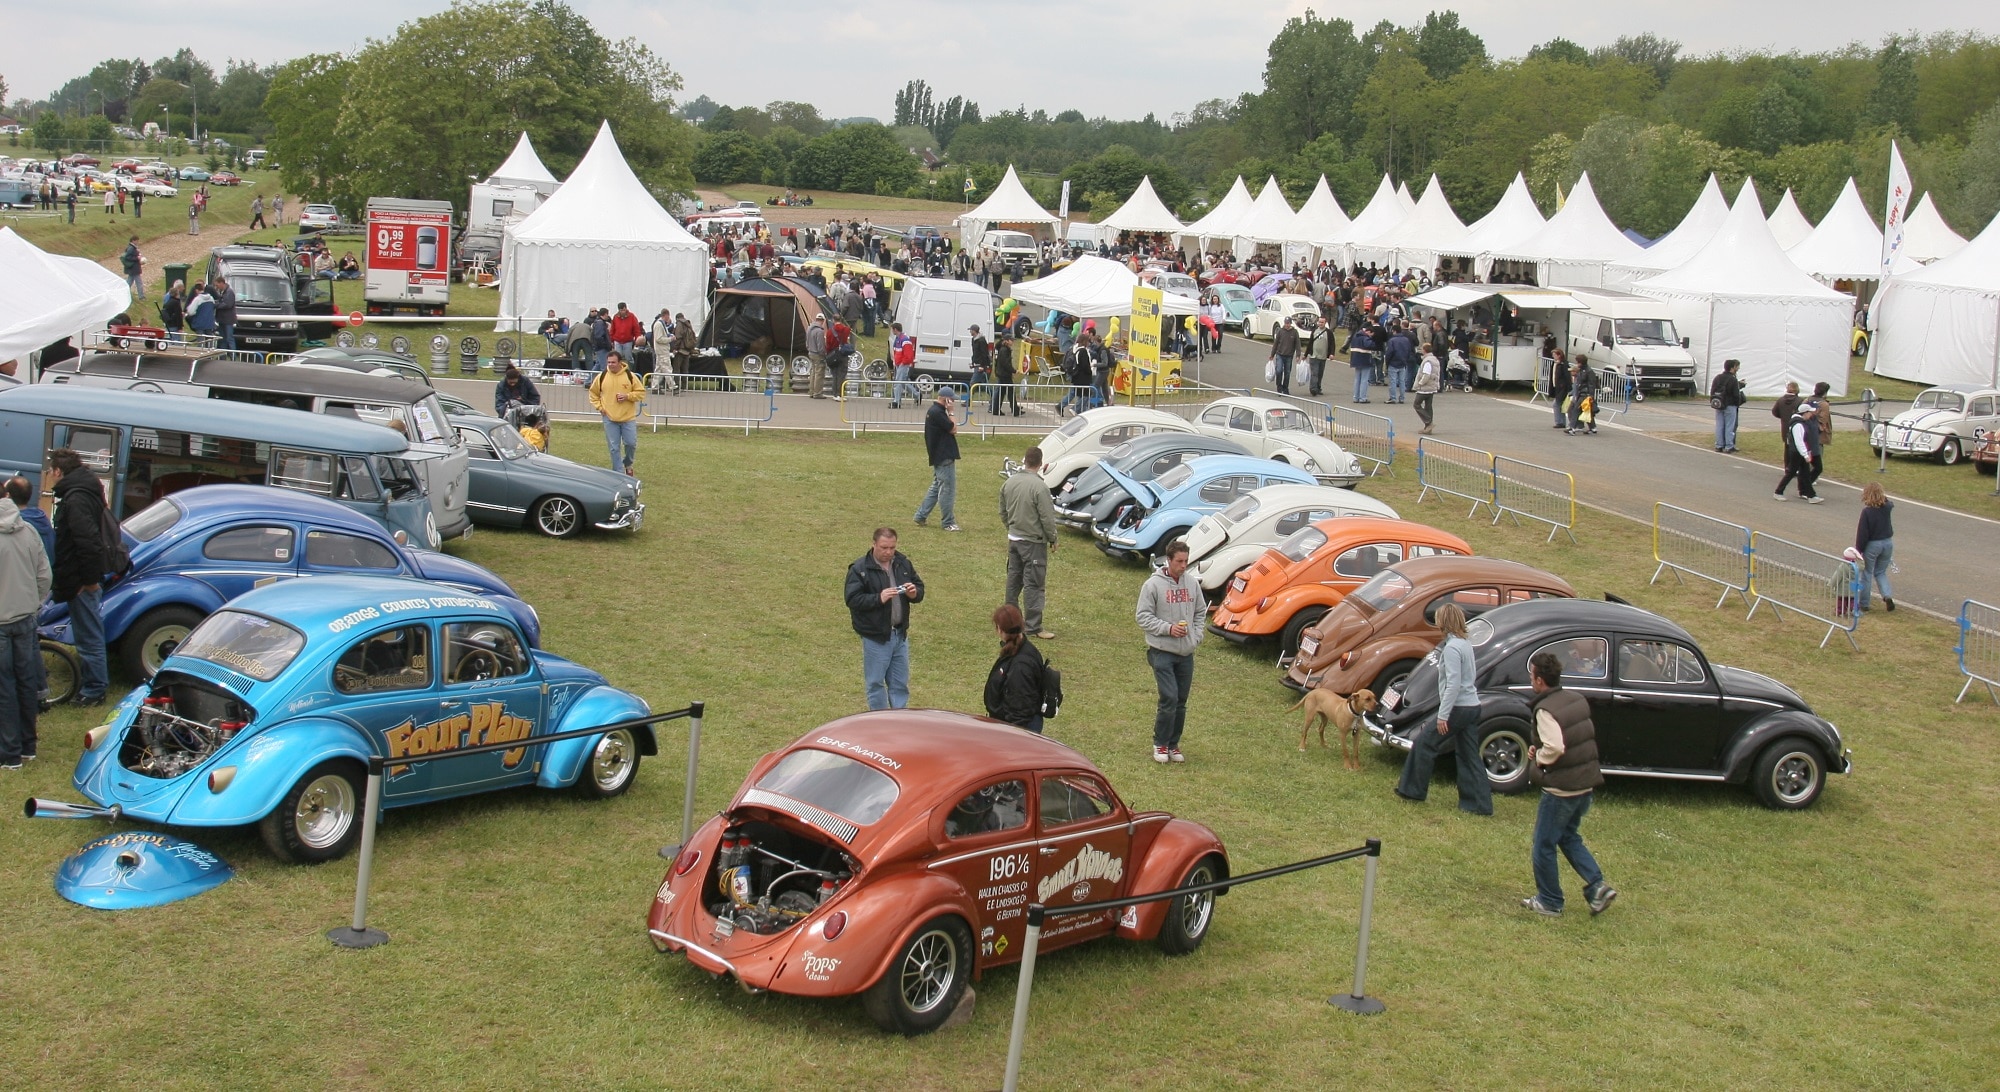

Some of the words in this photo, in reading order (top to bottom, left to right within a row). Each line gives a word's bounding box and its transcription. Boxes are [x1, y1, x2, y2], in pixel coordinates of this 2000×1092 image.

[1149, 335, 1157, 347] PRO
[384, 713, 470, 777] Four
[467, 701, 533, 767] Play
[816, 736, 850, 749] BEHNE
[848, 745, 902, 770] AVIATION
[989, 854, 1015, 881] 196
[998, 882, 1020, 896] CHASSIS
